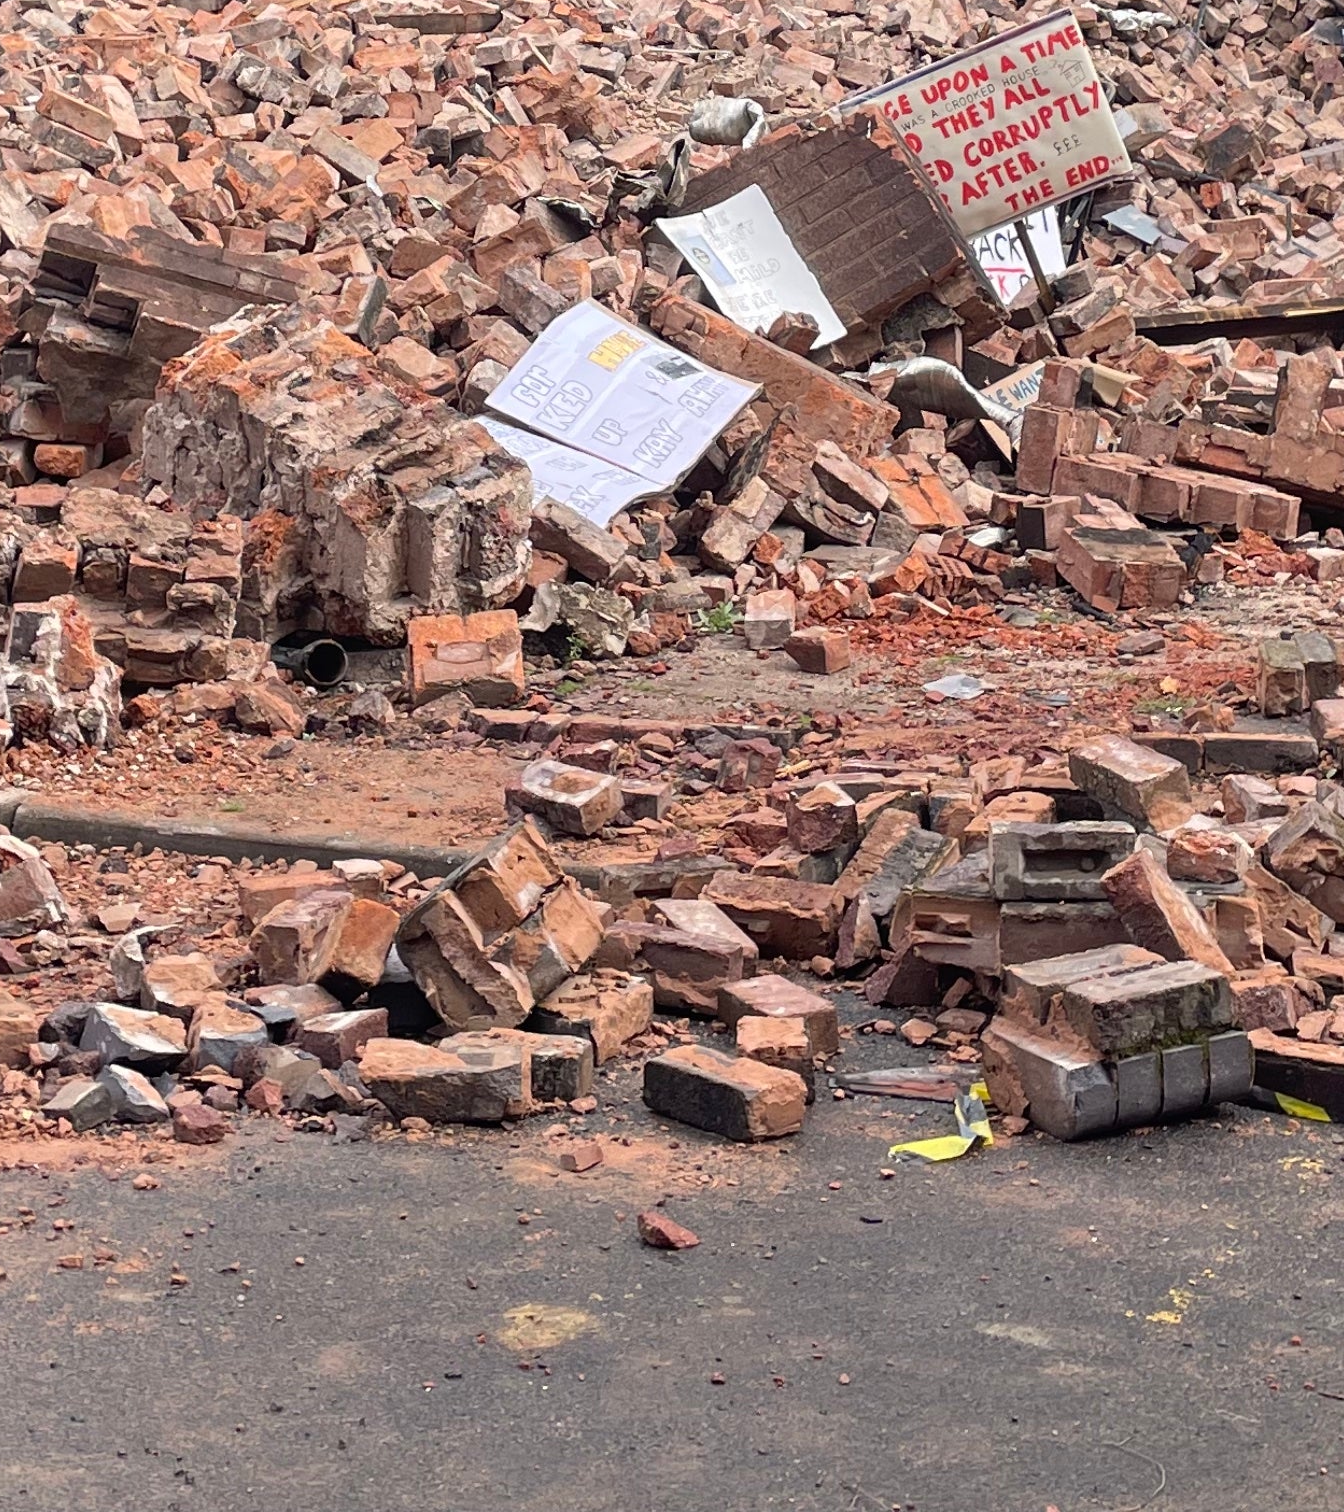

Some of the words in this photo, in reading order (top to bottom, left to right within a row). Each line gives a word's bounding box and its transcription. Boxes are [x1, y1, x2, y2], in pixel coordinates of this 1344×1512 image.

[883, 94, 913, 120] CE
[920, 64, 989, 105] UPON
[1000, 55, 1017, 74] A
[900, 115, 926, 133] WAS
[931, 109, 940, 118] A
[944, 83, 996, 113] CROOKED
[932, 97, 996, 139] THEY
[1004, 78, 1051, 110] ALL
[963, 80, 1101, 168] CORRUPTLY
[961, 151, 1046, 206] AFTER.
[1004, 179, 1055, 211] THE
[977, 229, 1024, 263] ACK
[536, 380, 593, 432] KED
[591, 418, 628, 447] UP
[633, 417, 684, 469] KAY
